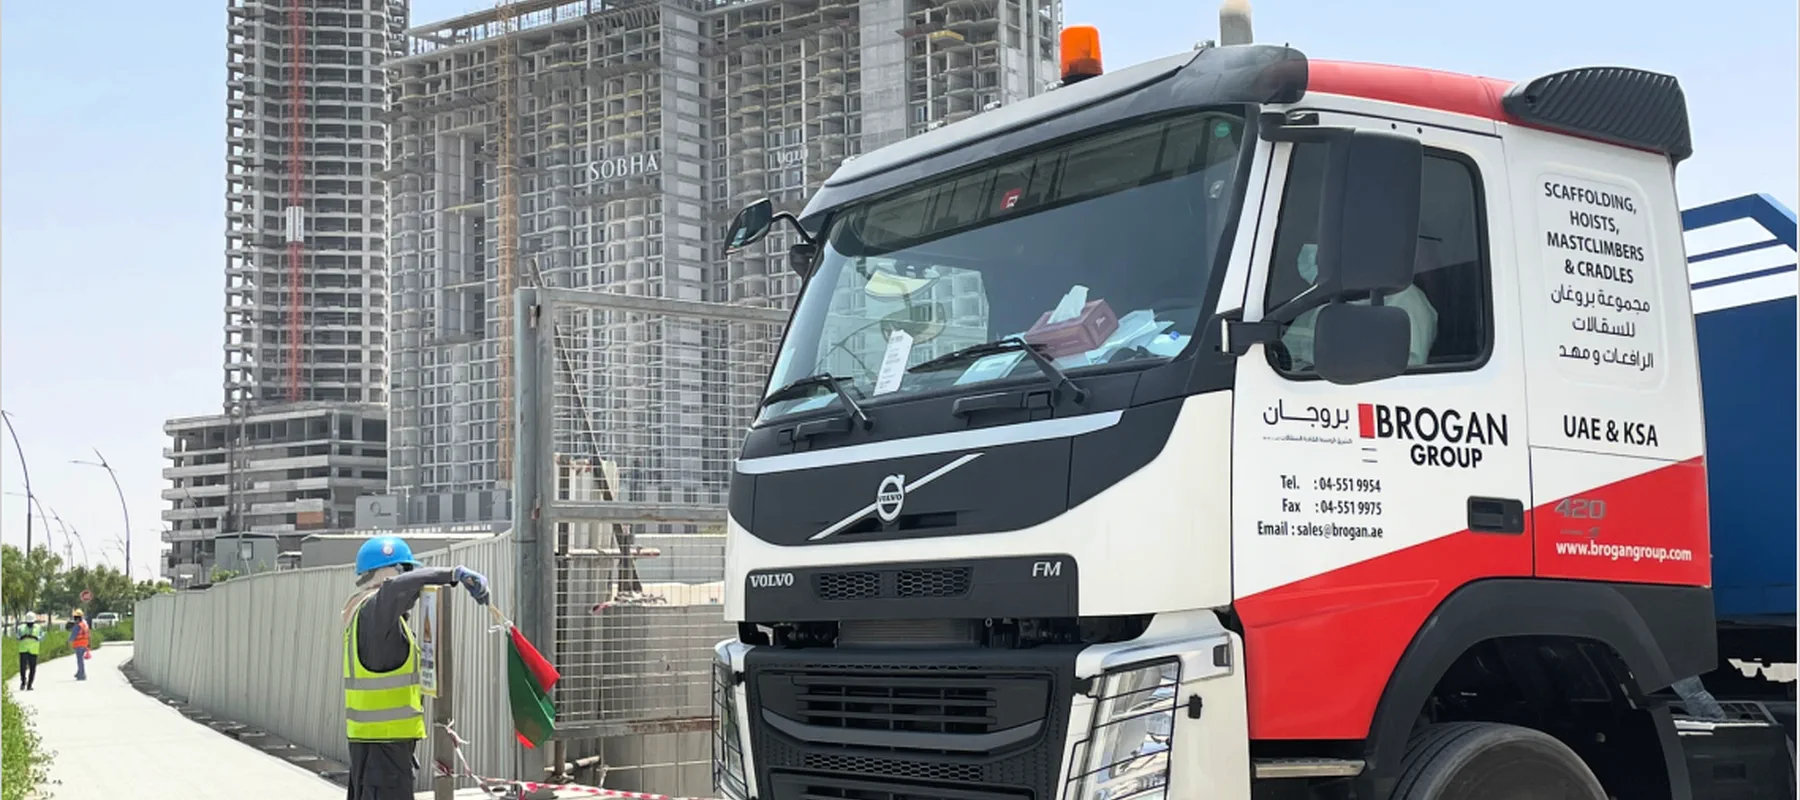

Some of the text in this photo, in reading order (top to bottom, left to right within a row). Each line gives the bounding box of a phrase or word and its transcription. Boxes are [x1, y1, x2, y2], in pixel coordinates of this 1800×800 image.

[589, 153, 658, 181] SOBHA
[1544, 182, 1636, 215] SCAFFOLDING,
[1570, 210, 1619, 235] HOISTS,
[1547, 231, 1644, 261] MASTCLIMBERS
[1564, 259, 1634, 284] & CRADLES
[1551, 284, 1650, 315] مجموعة بروغان
[1572, 316, 1635, 338] للسقالات
[1603, 347, 1654, 371] الرافعات
[1263, 399, 1349, 429] بروجان
[1376, 404, 1508, 446] BROGAN
[1563, 415, 1659, 447] UAE & KSA
[1410, 444, 1482, 468] GROUP
[1280, 475, 1300, 489] Tel.
[1356, 479, 1381, 492] 9954
[1282, 498, 1301, 512] Fax
[1357, 501, 1382, 515] 9975
[1554, 498, 1606, 519] 420
[1257, 520, 1288, 535] Email
[1297, 521, 1383, 541] sales@brogan.ae
[1555, 539, 1692, 563] www.brogangroup.com
[750, 572, 794, 588] VOLVO
[1032, 561, 1062, 577] FM
